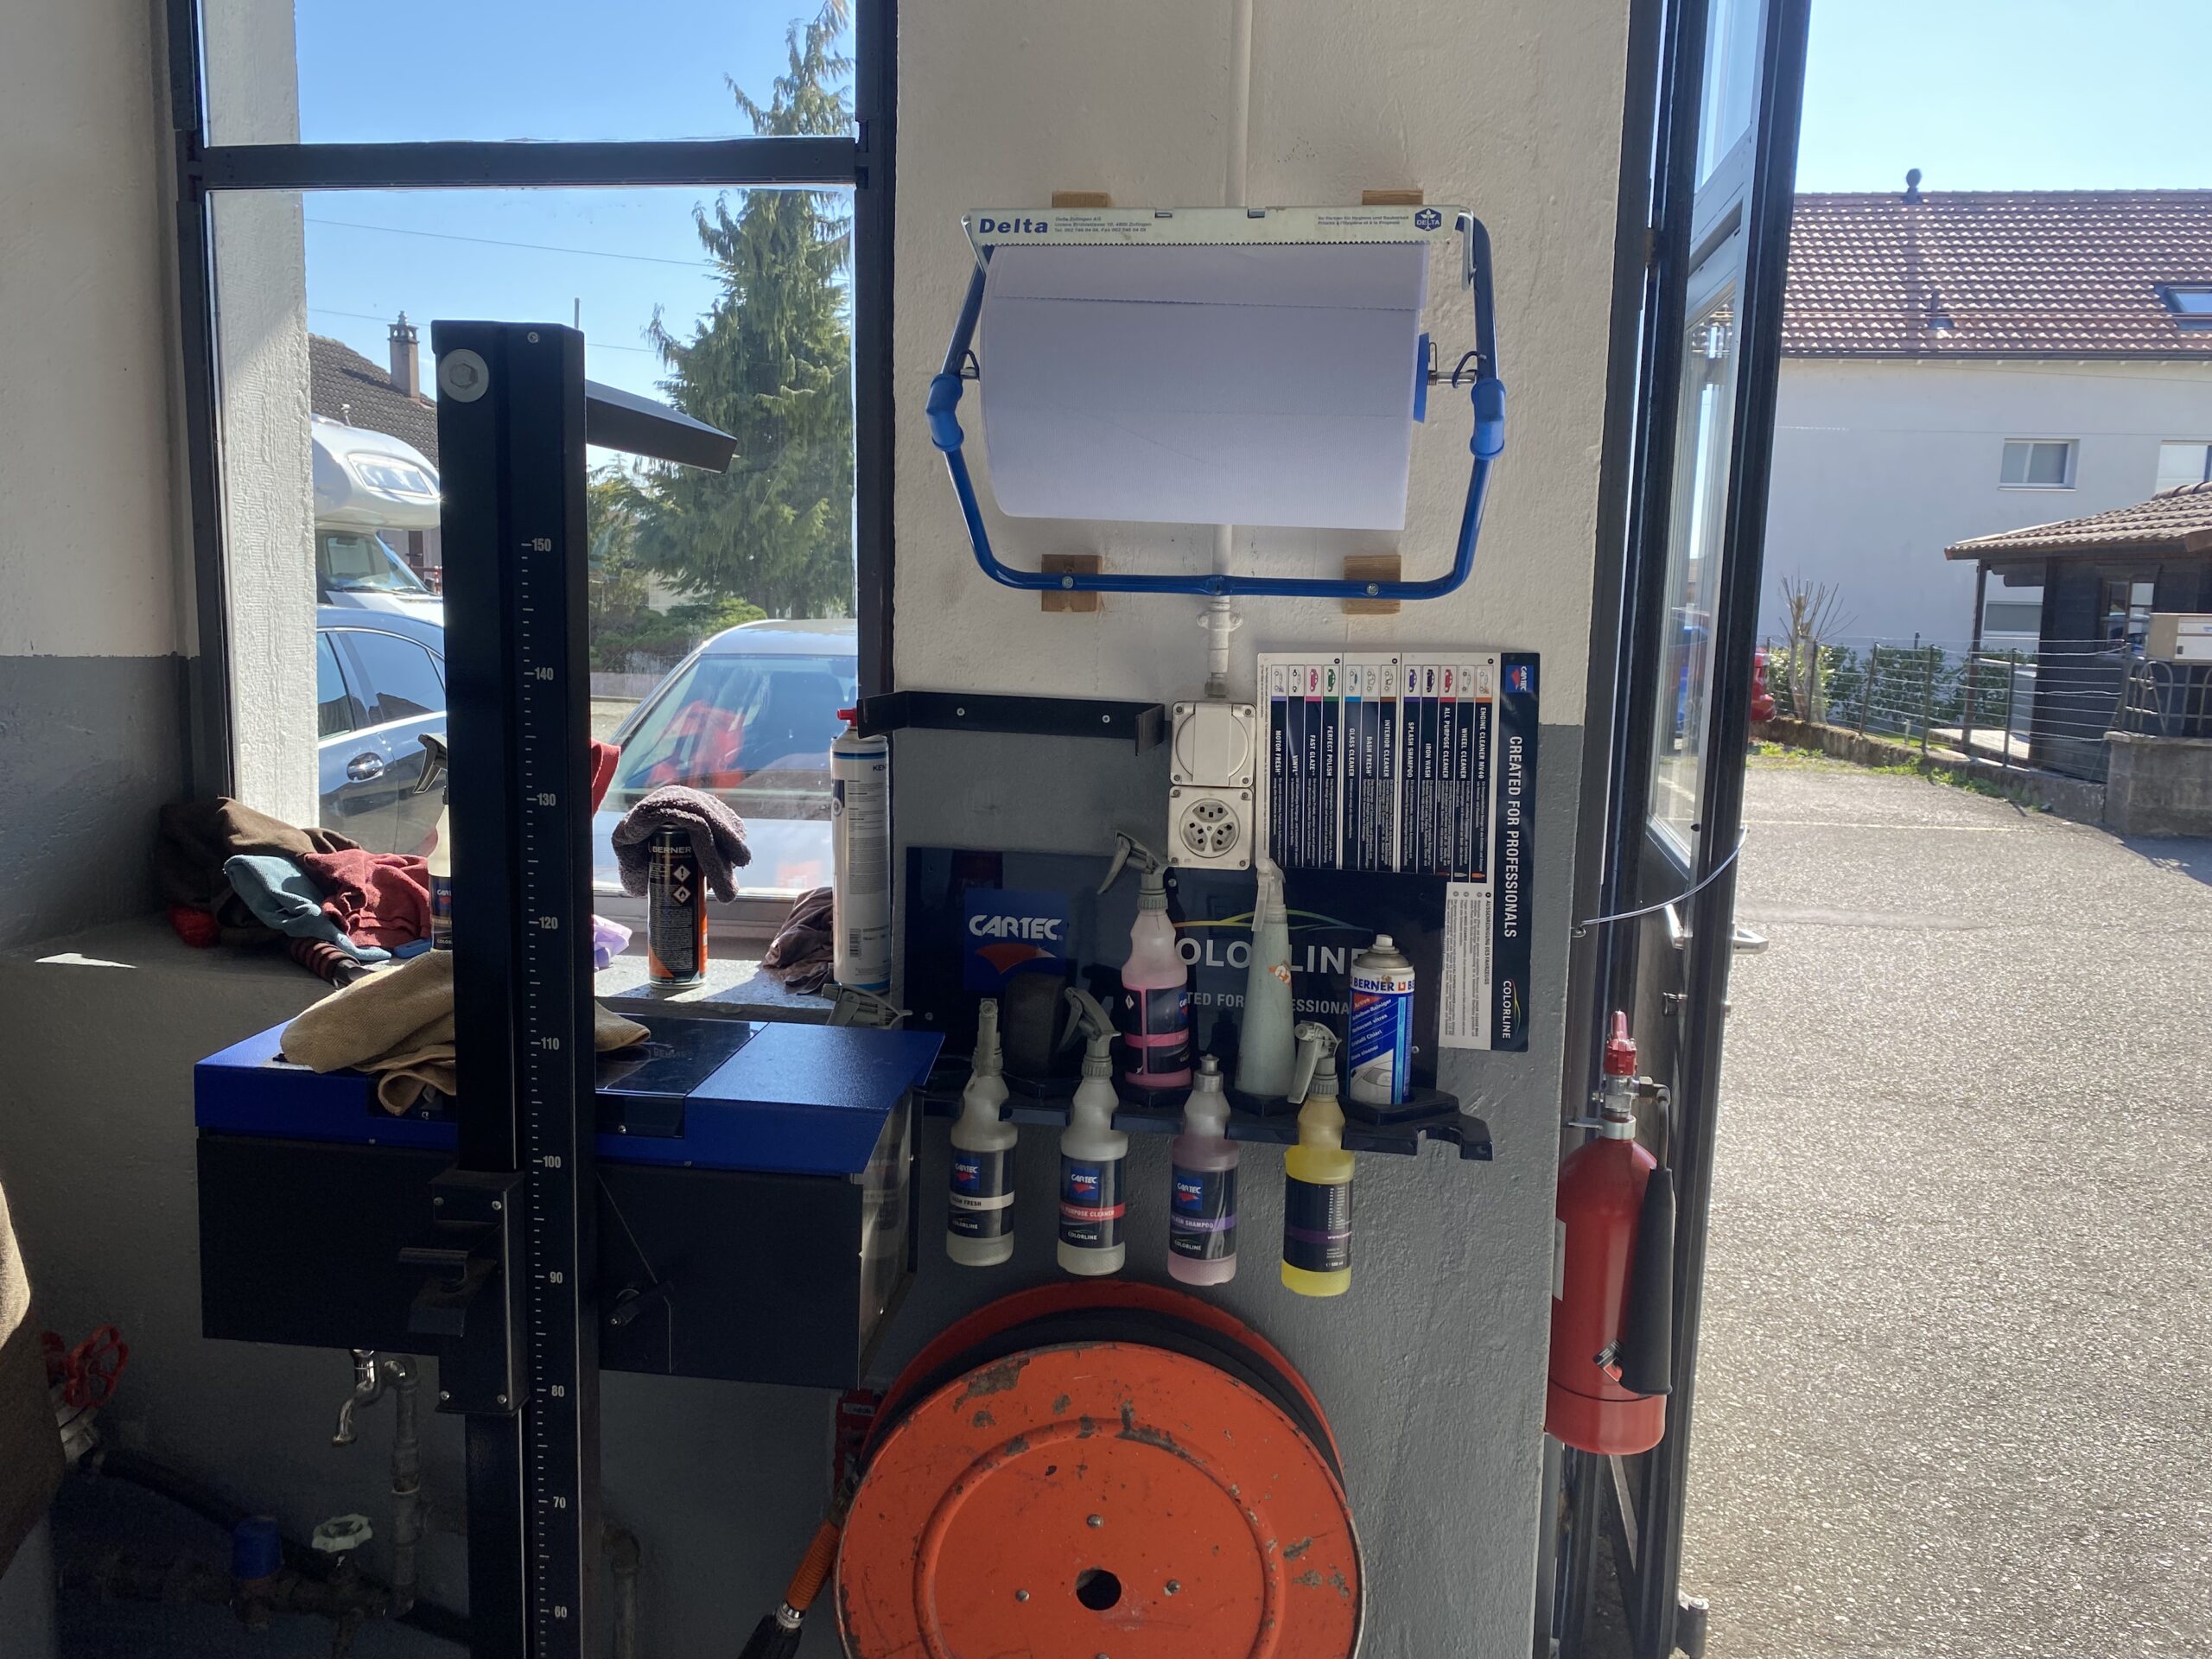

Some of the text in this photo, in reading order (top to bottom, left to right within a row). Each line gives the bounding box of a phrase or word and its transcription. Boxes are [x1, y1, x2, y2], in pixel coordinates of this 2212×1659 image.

[979, 218, 1049, 233] Delta
[532, 537, 552, 552] 150
[535, 667, 554, 681] 140
[537, 792, 556, 806] 130
[1503, 736, 1522, 938] CREATED FOR PROFESSIONALS
[539, 916, 558, 930] 120
[969, 914, 1063, 941] CARTEC
[1354, 976, 1395, 992] BERNER
[1217, 994, 1244, 1007] FOR
[1502, 980, 1512, 1039] COLORLINE
[541, 1037, 560, 1051] 110
[543, 1155, 562, 1168] 100
[955, 1163, 979, 1174] CARTEC
[1071, 1173, 1098, 1184] CARTEC
[1177, 1182, 1202, 1194] CARTEC
[1185, 1219, 1214, 1229] SHAMPOO
[1067, 1230, 1097, 1241] COLORLINE
[1174, 1239, 1202, 1251] COLORLINE
[550, 1271, 563, 1284] 90
[552, 1385, 565, 1397] 80
[554, 1497, 566, 1509] 70
[555, 1606, 568, 1618] 60
